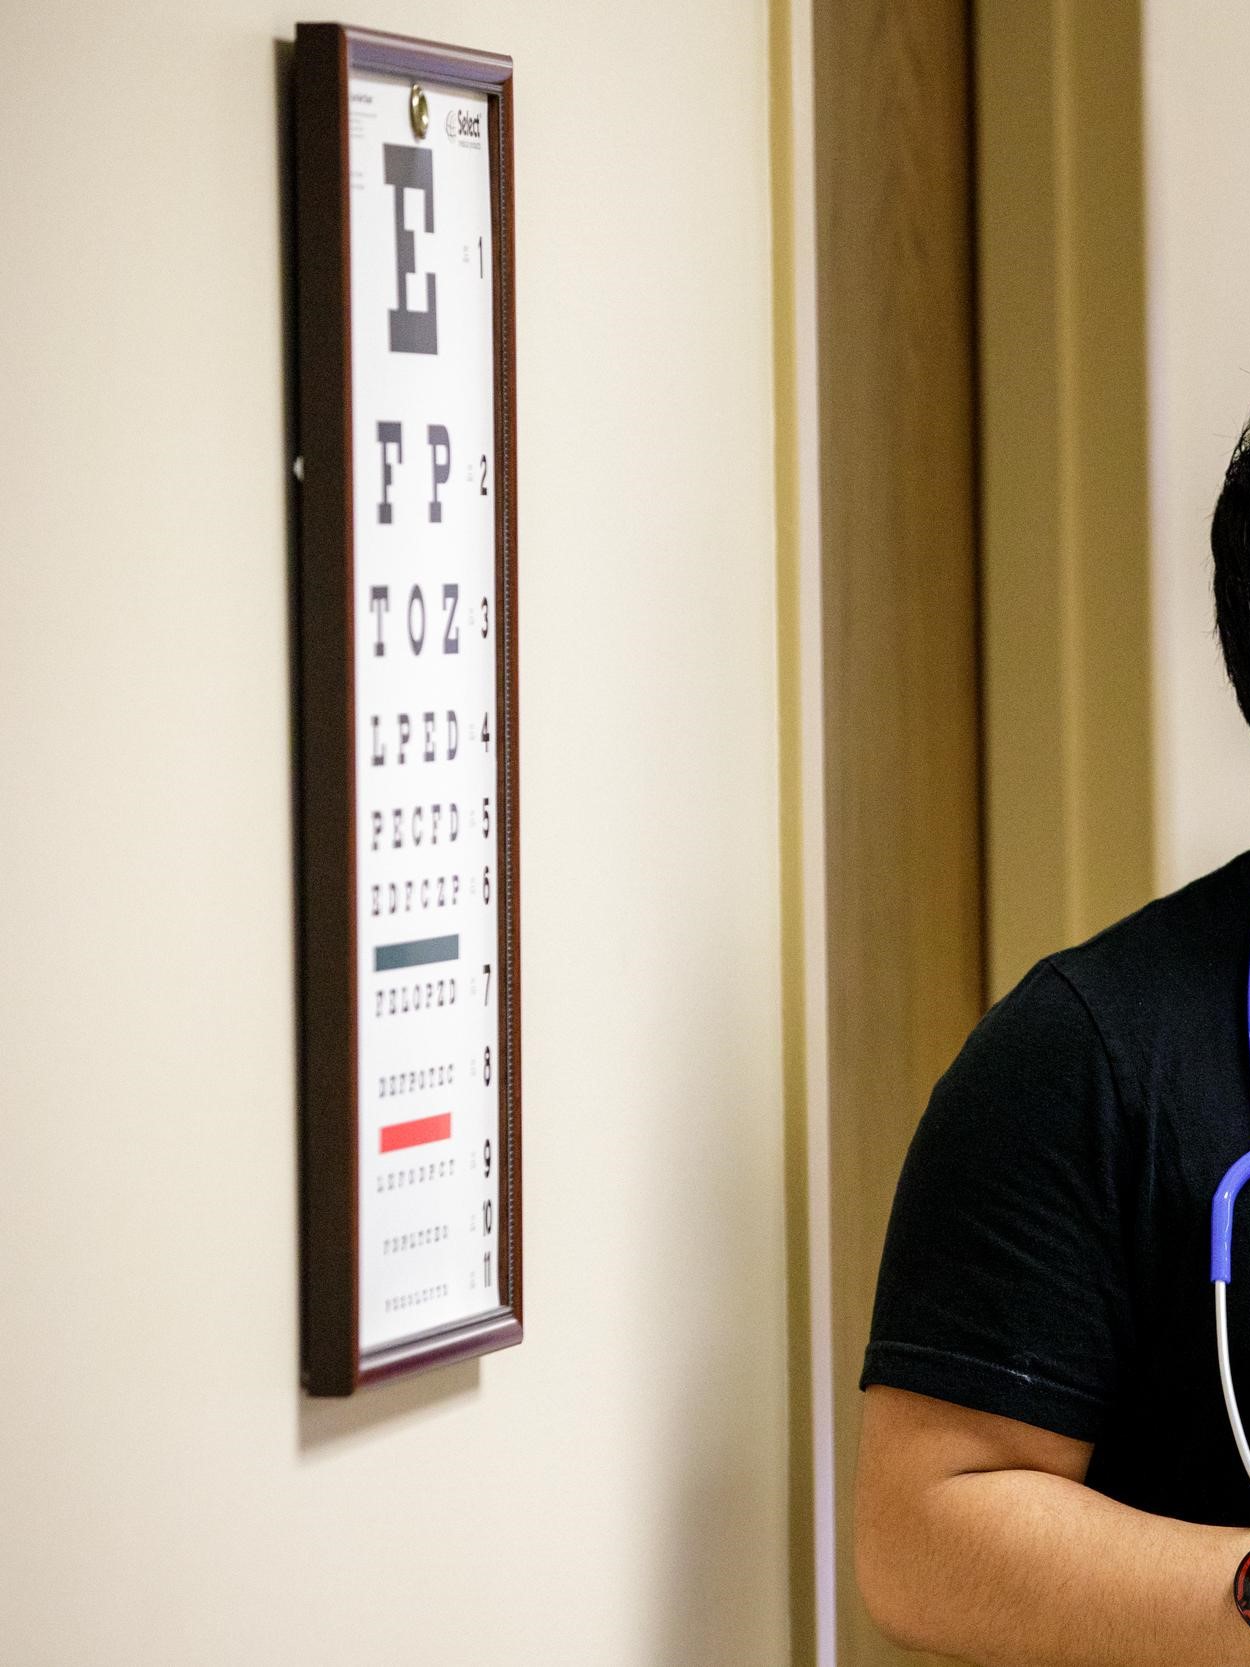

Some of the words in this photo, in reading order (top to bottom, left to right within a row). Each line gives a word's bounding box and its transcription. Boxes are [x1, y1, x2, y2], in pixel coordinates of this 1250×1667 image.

[457, 109, 480, 138] Select
[383, 143, 438, 355] E
[480, 454, 488, 495] 2
[370, 583, 459, 657] TOZ
[480, 597, 489, 639] 3
[371, 709, 459, 767] LPED
[481, 711, 490, 753] 4
[371, 803, 459, 851] PECFD
[483, 797, 490, 839] 5
[482, 865, 490, 906] 6
[483, 964, 491, 1007] 7
[483, 1045, 491, 1088] 8
[483, 1138, 491, 1179] 9
[482, 1199, 493, 1237] 10
[483, 1251, 491, 1288] 11
